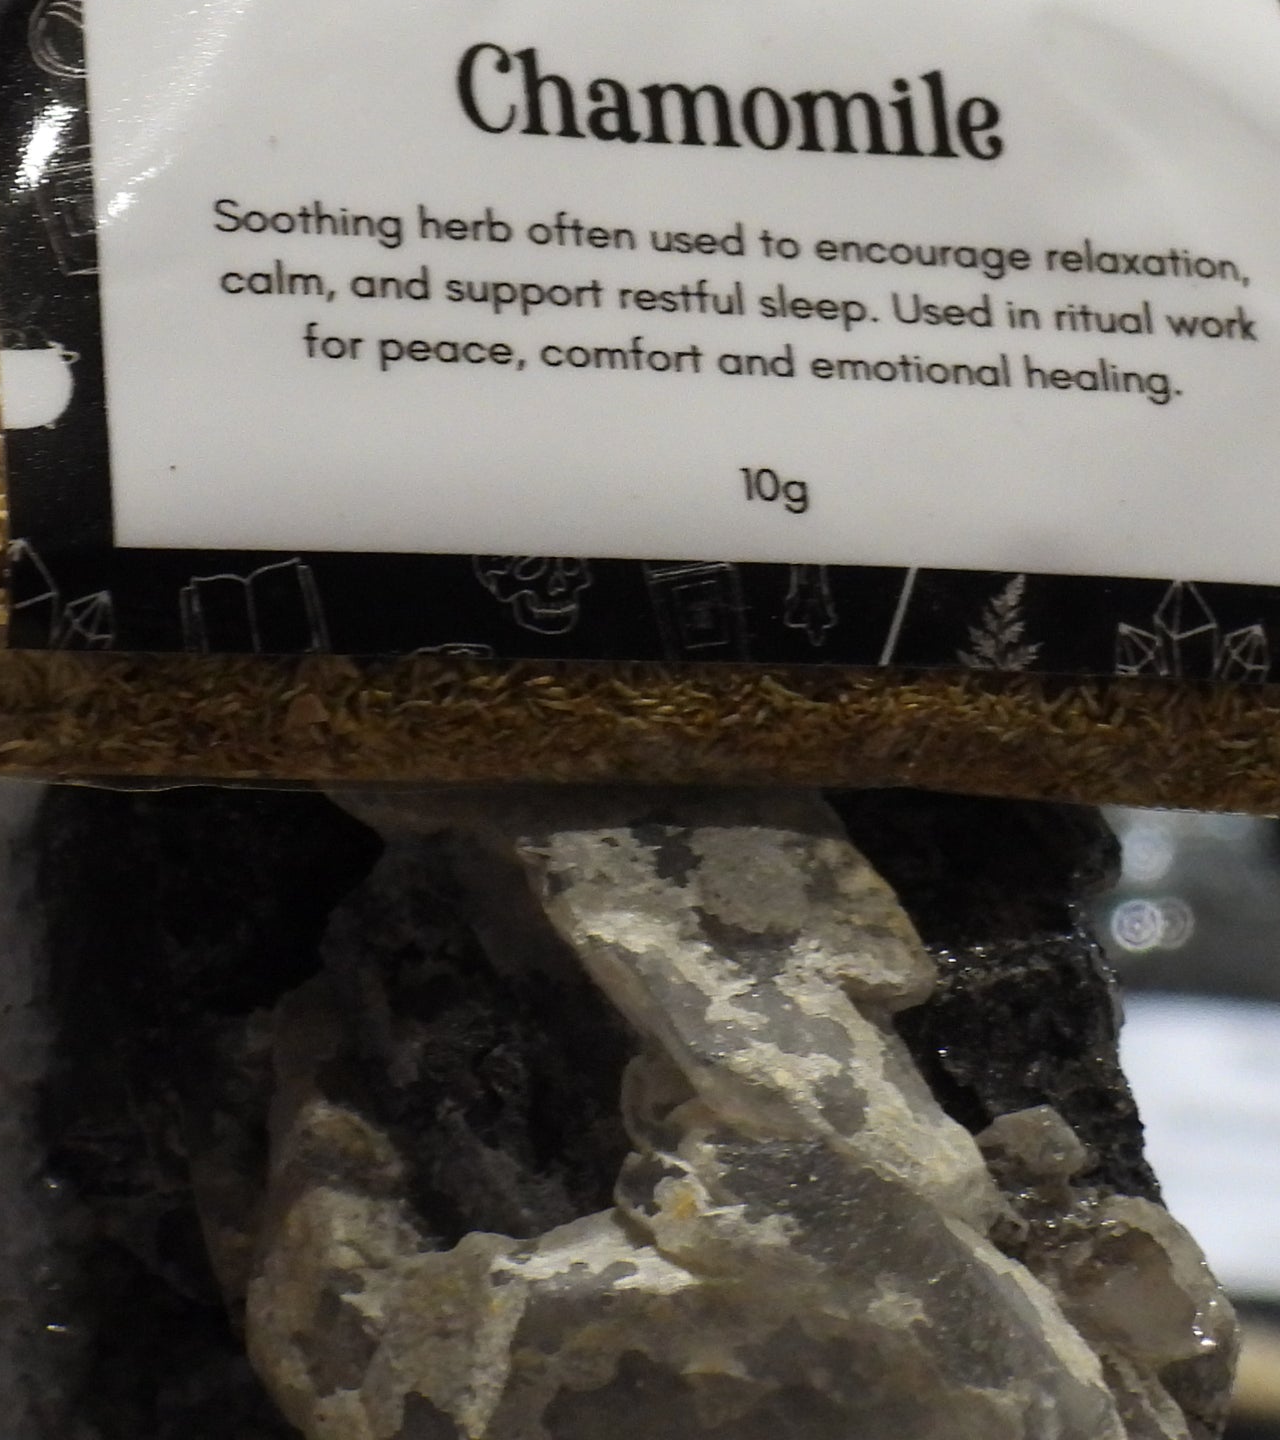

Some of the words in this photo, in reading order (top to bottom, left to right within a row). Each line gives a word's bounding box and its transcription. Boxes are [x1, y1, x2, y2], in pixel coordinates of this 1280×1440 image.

[456, 43, 1005, 162] Chamomile
[214, 199, 403, 249] Soothing
[418, 204, 513, 243] herb
[527, 211, 636, 250] often
[650, 222, 745, 256] used
[759, 230, 801, 260] to
[814, 240, 1032, 280] encourage
[1045, 238, 1249, 286] relaxation,
[220, 259, 336, 302] calm,
[350, 265, 431, 301] and
[446, 280, 604, 316] support
[619, 279, 745, 315] restful
[759, 284, 879, 332] sleep.
[892, 293, 993, 327] Used
[1008, 308, 1040, 329] in
[1054, 301, 1153, 334] ritual
[1166, 306, 1257, 341] work
[302, 322, 364, 360] for
[378, 339, 526, 372] peace,
[540, 336, 703, 373] comfort
[718, 344, 795, 377] and
[810, 353, 1011, 387] emotional
[1023, 355, 1182, 405] healing.
[739, 468, 809, 514] 10g
